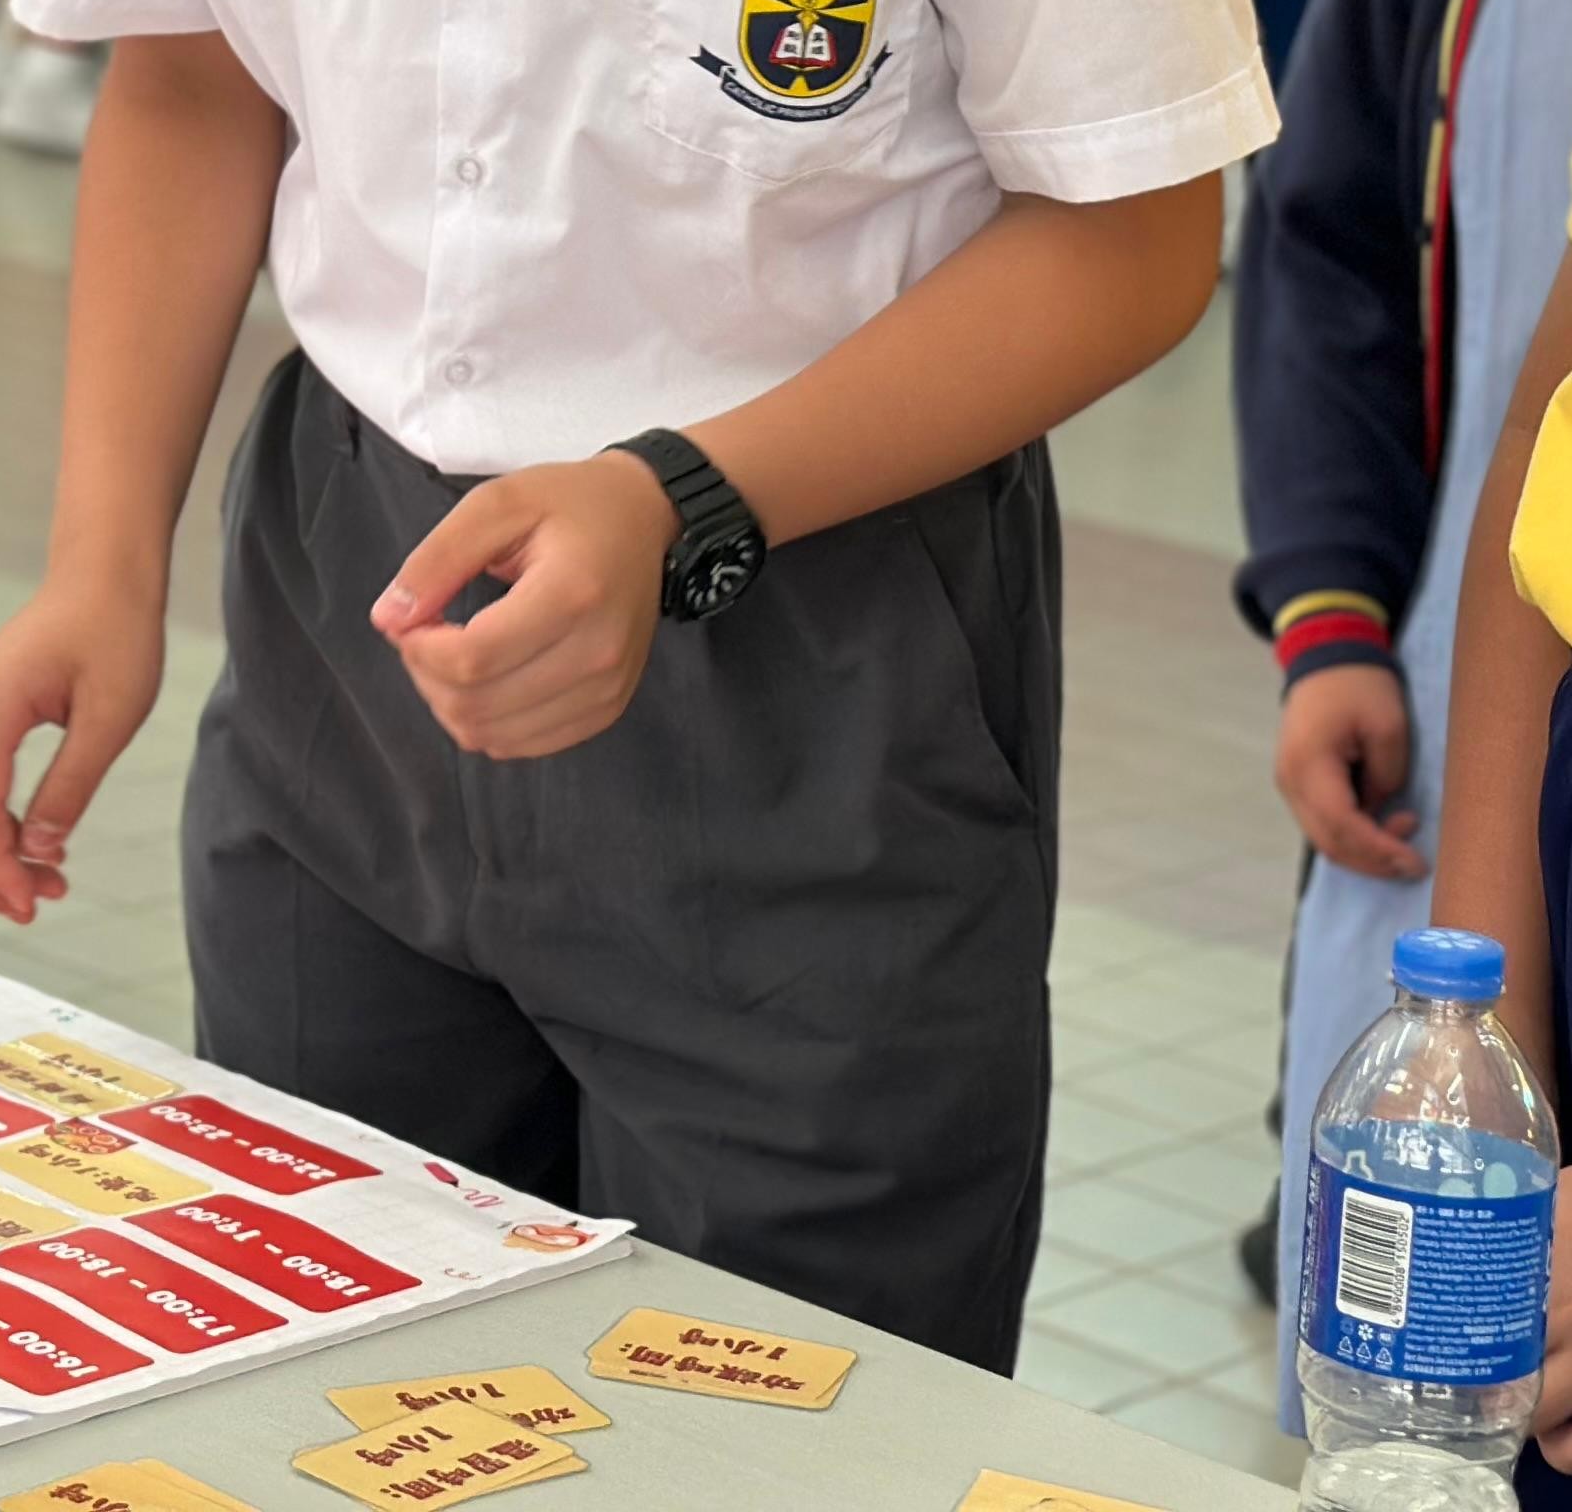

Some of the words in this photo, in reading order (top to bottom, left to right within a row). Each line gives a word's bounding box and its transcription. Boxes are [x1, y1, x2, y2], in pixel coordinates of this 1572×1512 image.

[149, 1105, 233, 1140] 23:00
[250, 1146, 337, 1180] 22:00
[175, 1206, 261, 1242] 19:00
[38, 1241, 126, 1278] 18:00
[282, 1256, 371, 1296] 18:00
[147, 1289, 236, 1337] 17:00
[8, 1330, 99, 1378] 16:00
[679, 1328, 788, 1360] 1小時
[356, 1425, 453, 1467] 1小時
